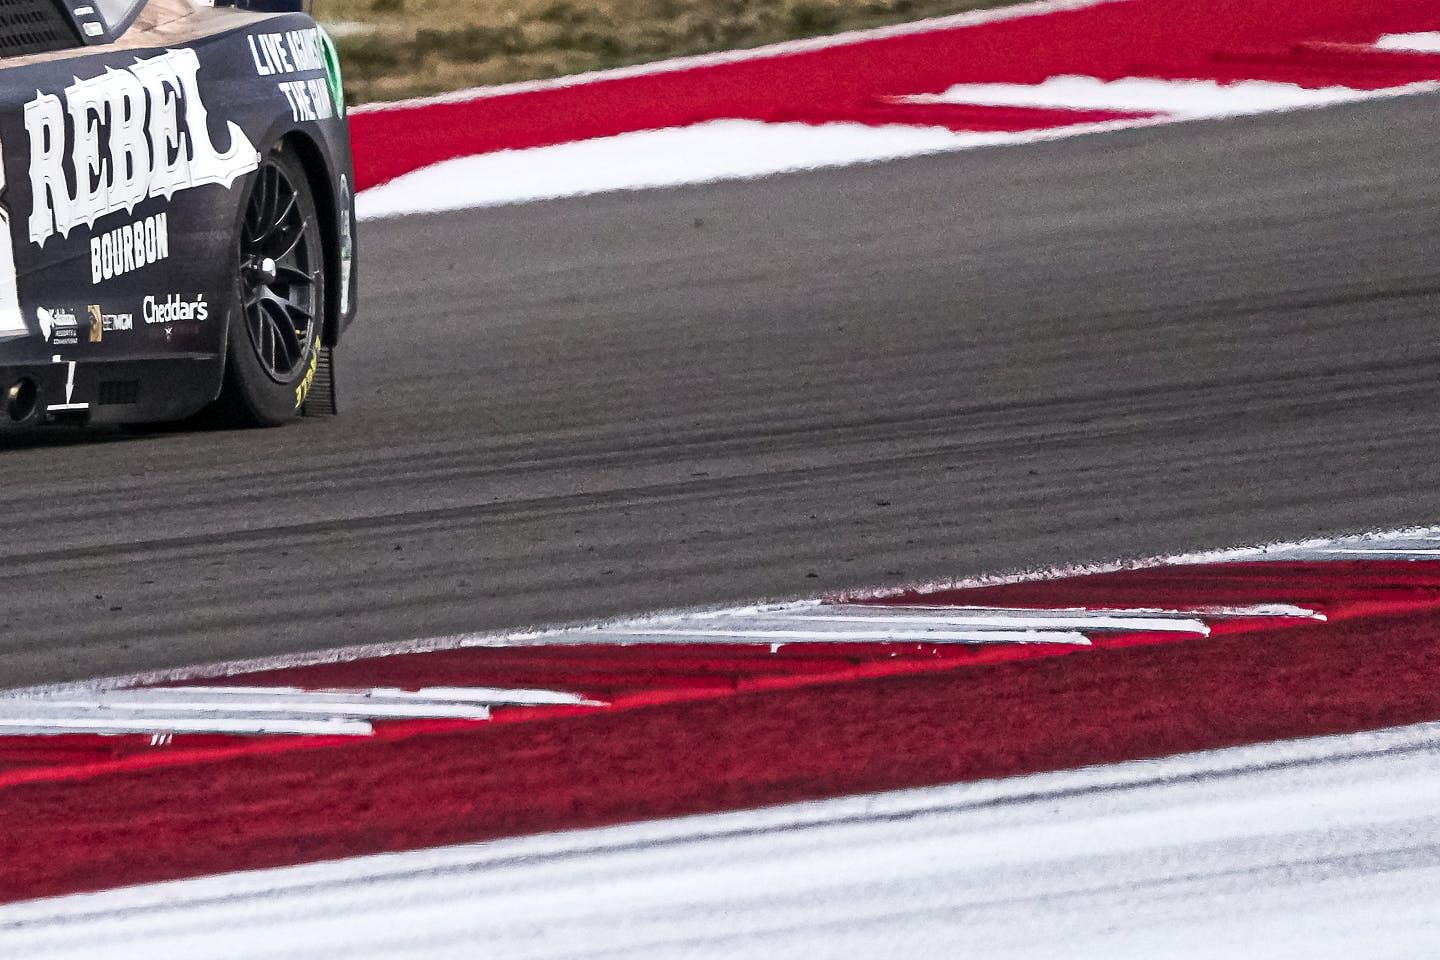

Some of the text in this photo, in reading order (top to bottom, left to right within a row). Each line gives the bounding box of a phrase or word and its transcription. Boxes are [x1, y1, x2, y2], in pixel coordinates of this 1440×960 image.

[246, 32, 295, 77] LIVE
[277, 79, 316, 123] THE
[23, 47, 259, 249] REBEL
[90, 212, 169, 285] BOURBON
[142, 293, 209, 325] Cheddar's
